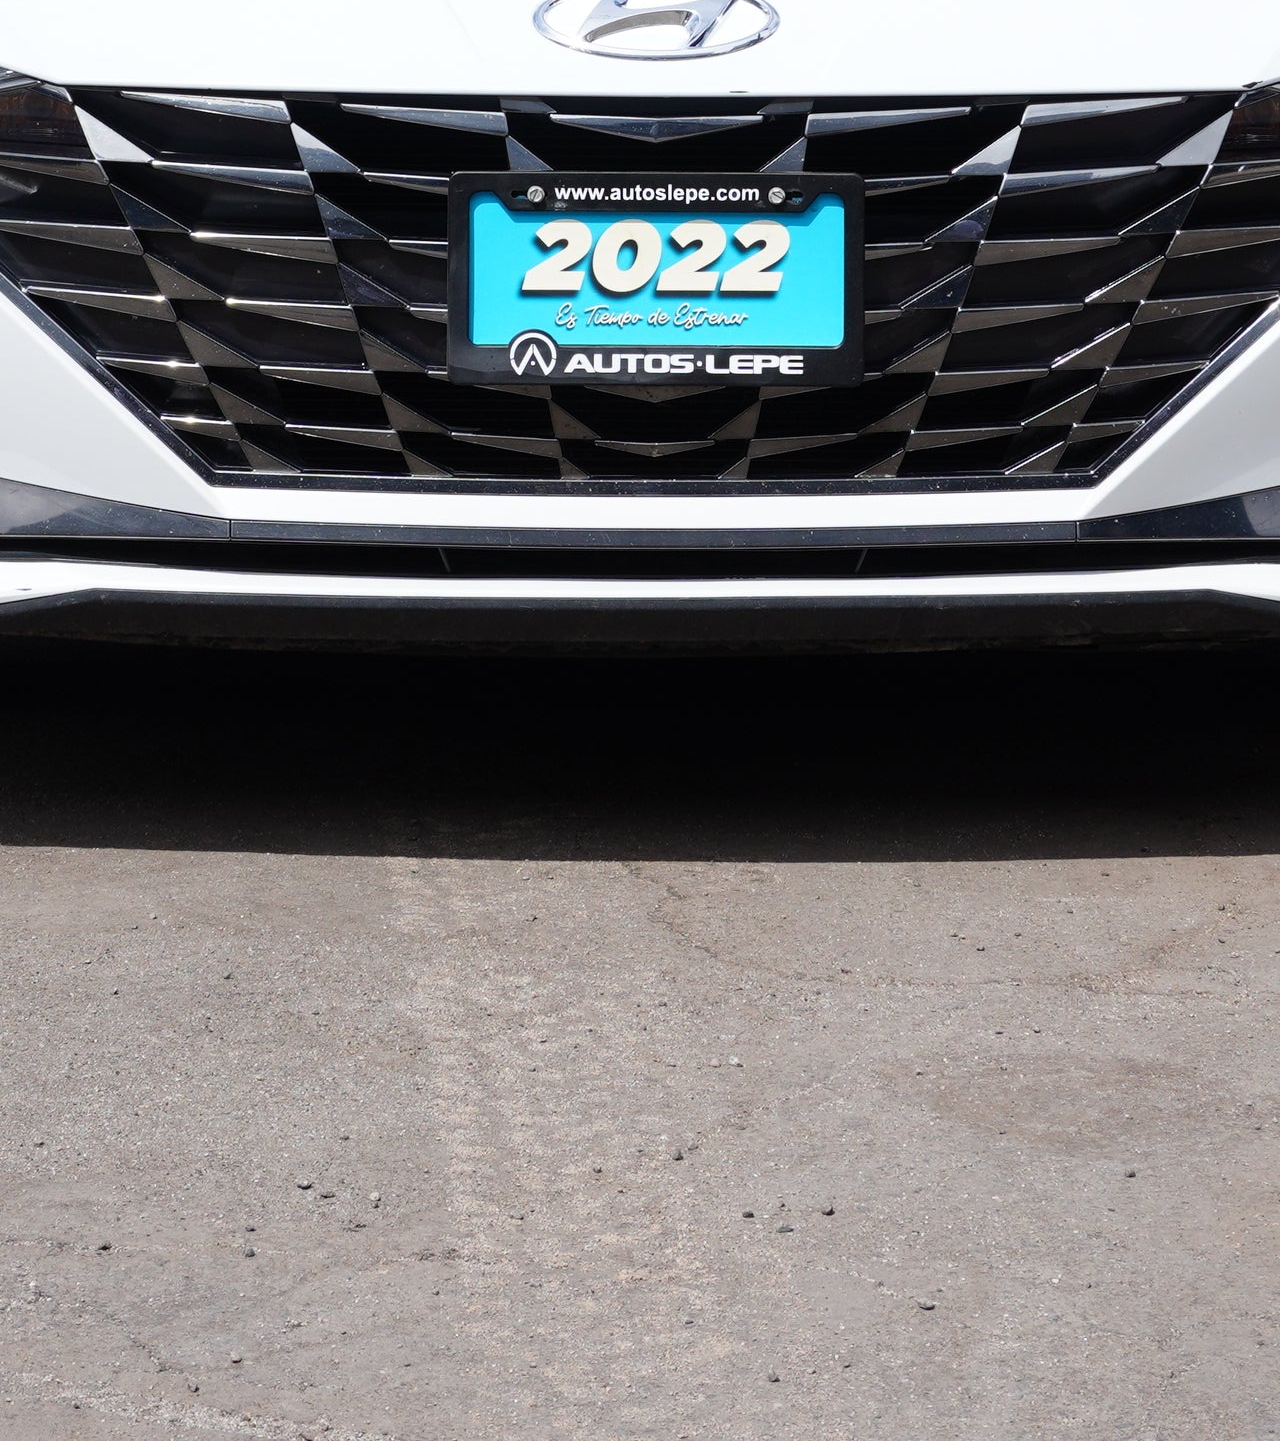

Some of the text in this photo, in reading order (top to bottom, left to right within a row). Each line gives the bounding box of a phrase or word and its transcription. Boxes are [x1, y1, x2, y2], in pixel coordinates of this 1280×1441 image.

[554, 184, 760, 204] www.autoslepe.com
[521, 218, 791, 293] 2022
[554, 302, 749, 330] Es Tiempo de Estrenar
